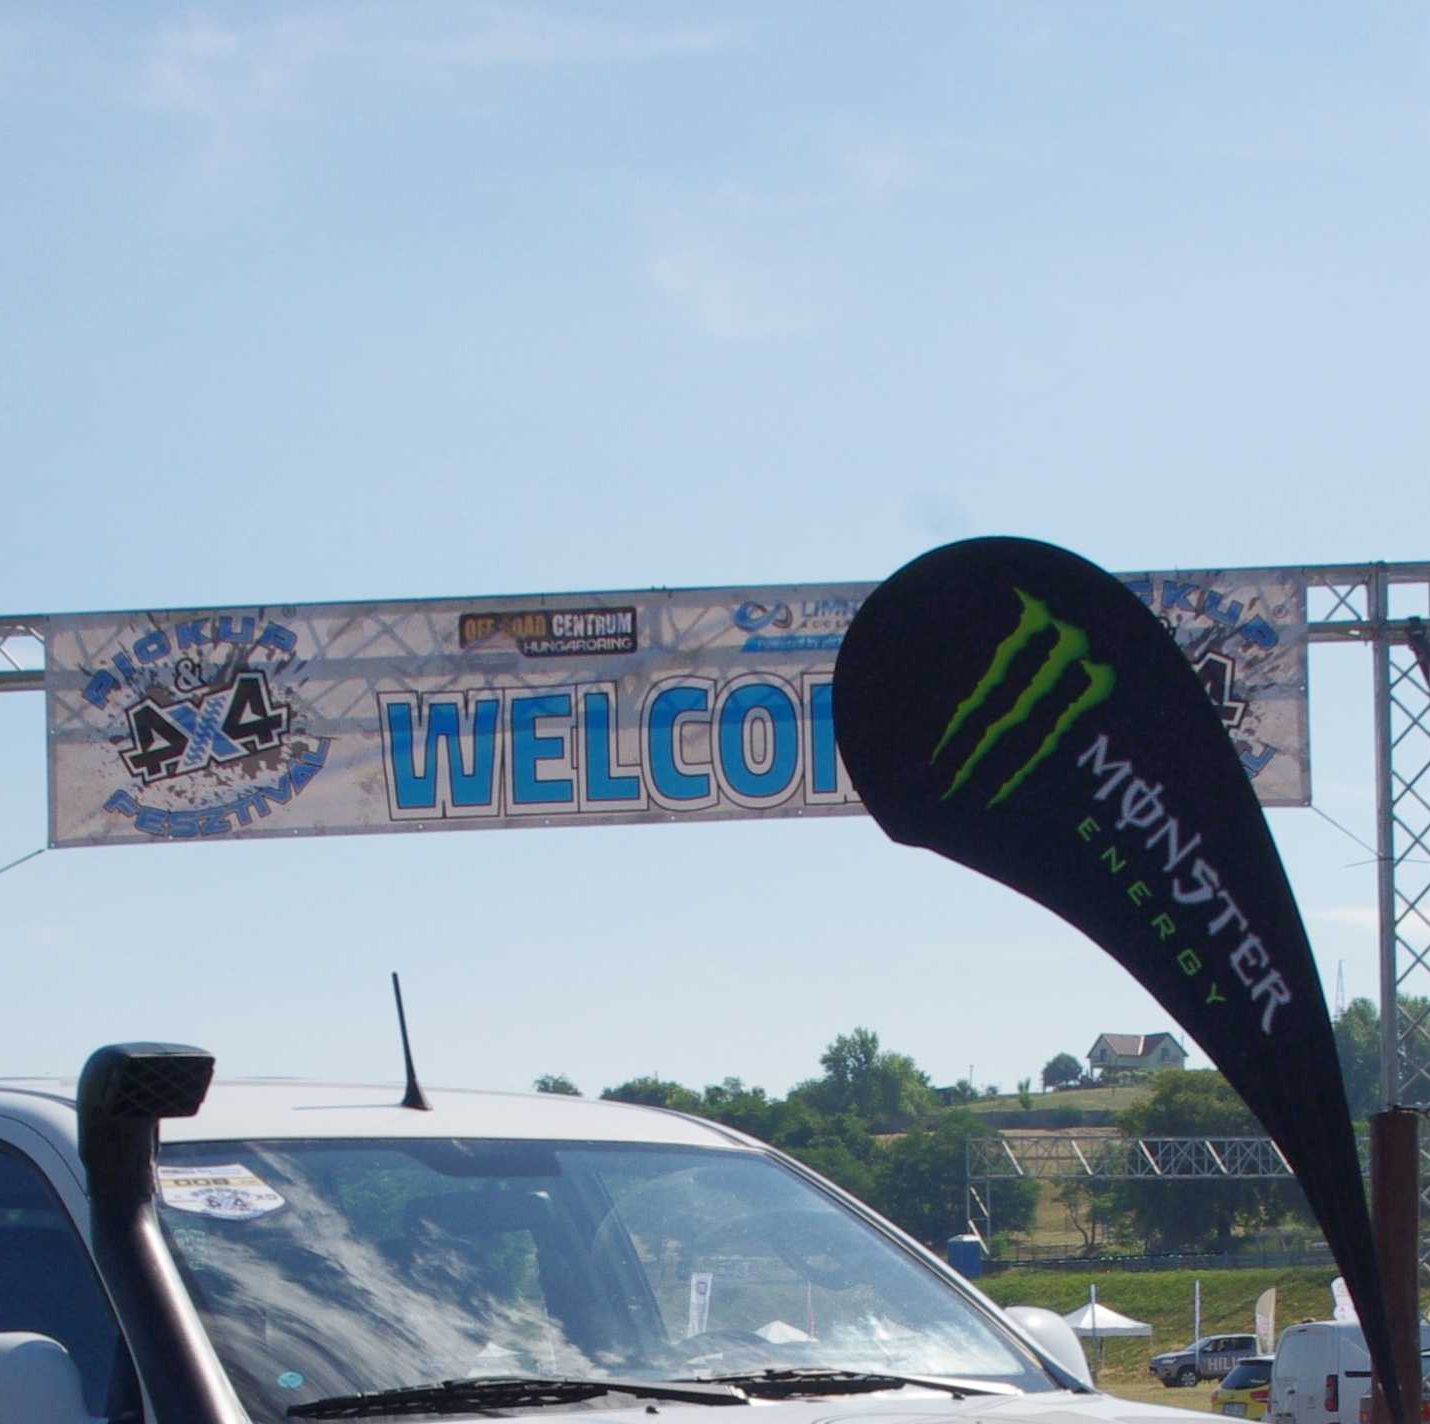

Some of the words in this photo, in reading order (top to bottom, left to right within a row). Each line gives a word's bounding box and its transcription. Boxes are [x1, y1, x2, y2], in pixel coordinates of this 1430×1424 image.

[82, 616, 297, 710] PICKUP
[464, 617, 495, 641] OFF
[552, 612, 633, 637] CENTRUM
[523, 637, 633, 653] HUNGARORING
[174, 658, 205, 693] &
[103, 737, 331, 837] FESZTIVAL
[377, 672, 861, 820] WELCO
[1077, 815, 1227, 1005] ENERGY
[1078, 733, 1292, 1037] MONSTER
